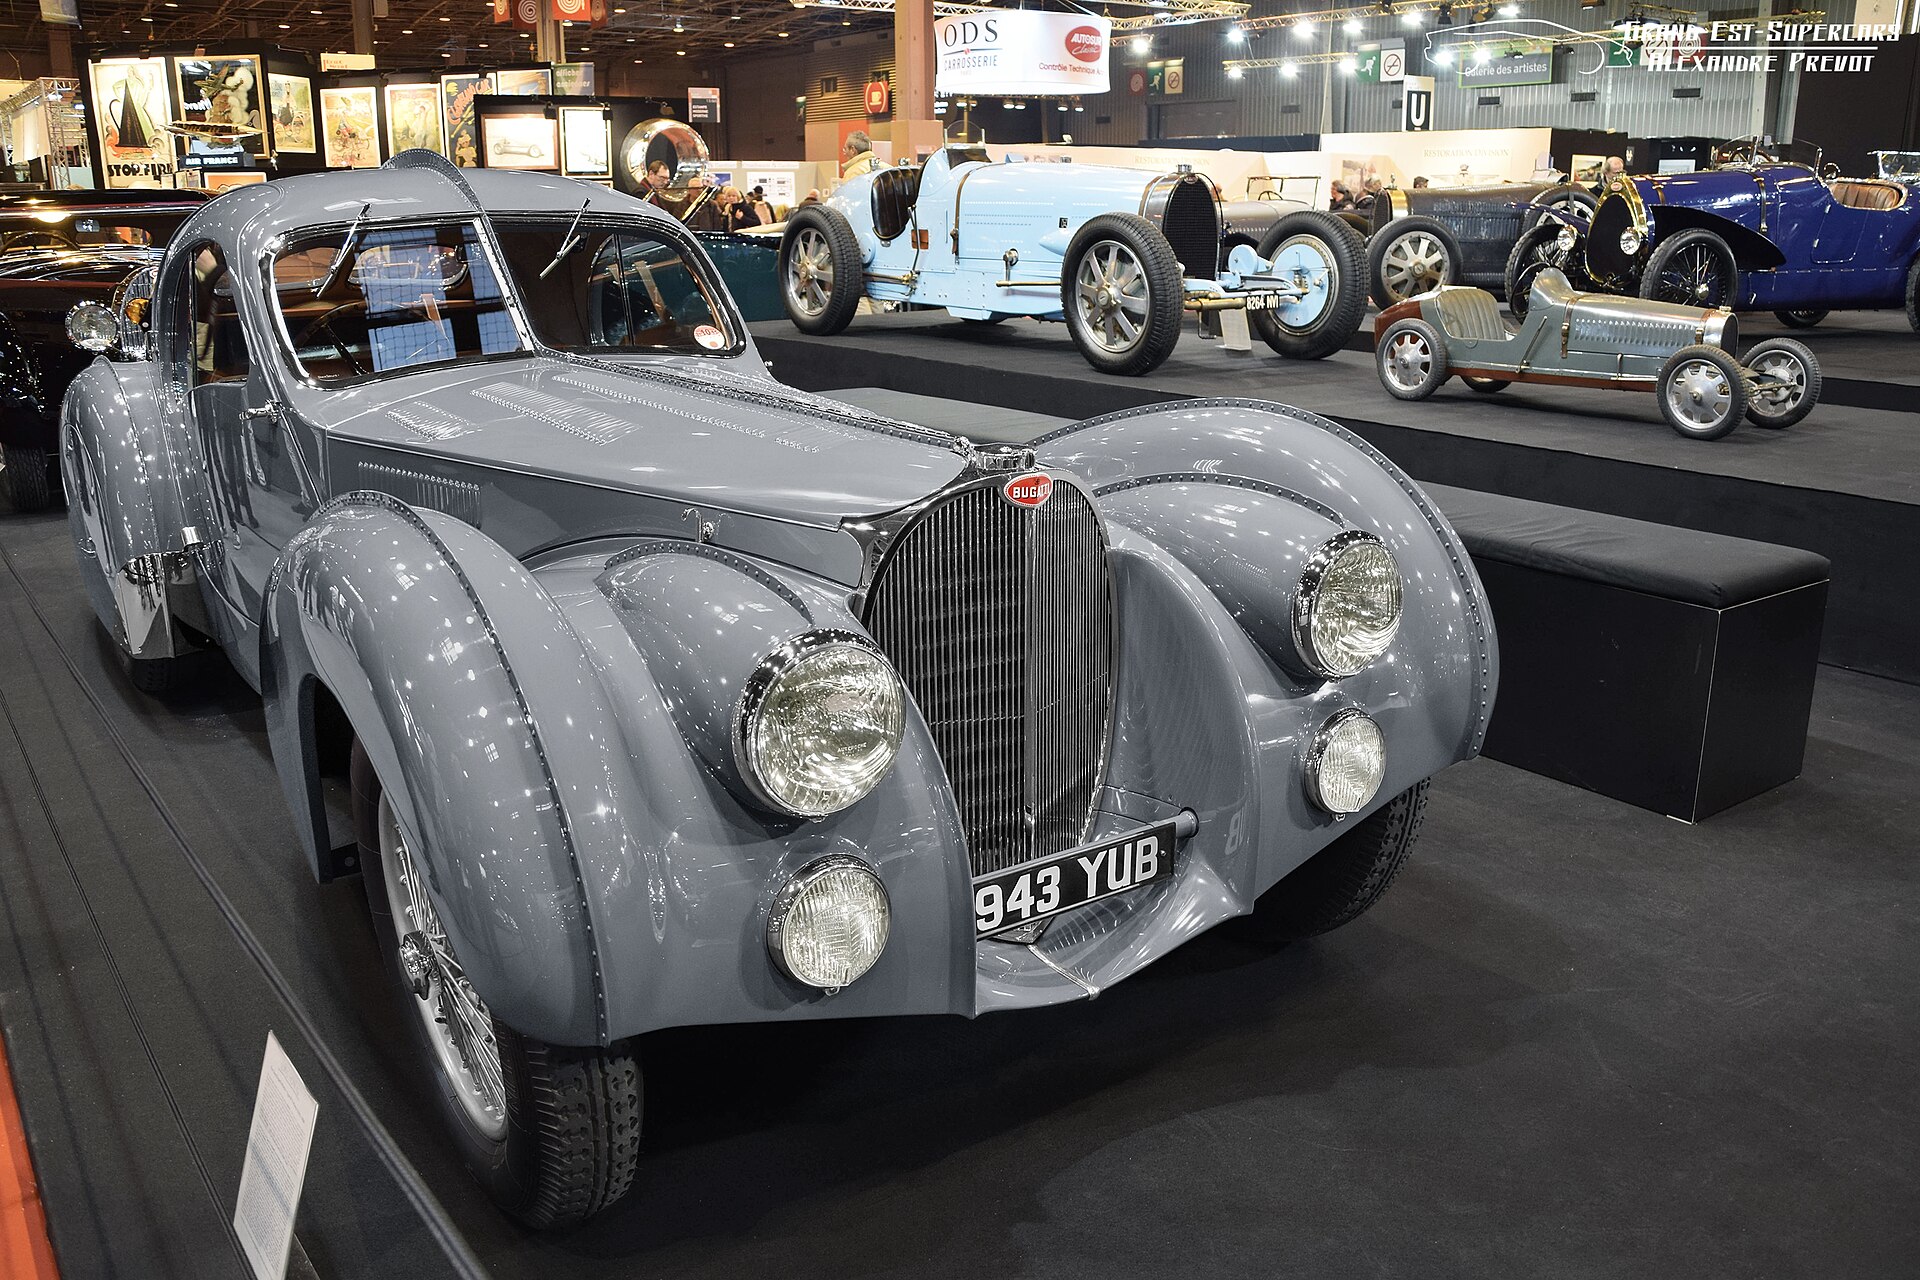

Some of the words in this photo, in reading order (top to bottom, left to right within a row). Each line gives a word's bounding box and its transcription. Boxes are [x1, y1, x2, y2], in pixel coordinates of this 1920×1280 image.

[944, 19, 998, 47] ODS
[943, 55, 998, 71] CARROSSERIE
[1039, 62, 1067, 71] Contrôle
[1068, 64, 1096, 75] Technique
[1465, 66, 1495, 77] Galerie
[1496, 64, 1512, 75] des
[1513, 62, 1548, 73] artistes
[1410, 93, 1426, 127] U
[185, 158, 202, 166] AIR
[1246, 294, 1265, 310] 8264
[1013, 483, 1050, 498] BUGATTI
[975, 866, 1061, 932] 943
[1077, 836, 1159, 899] YUB
